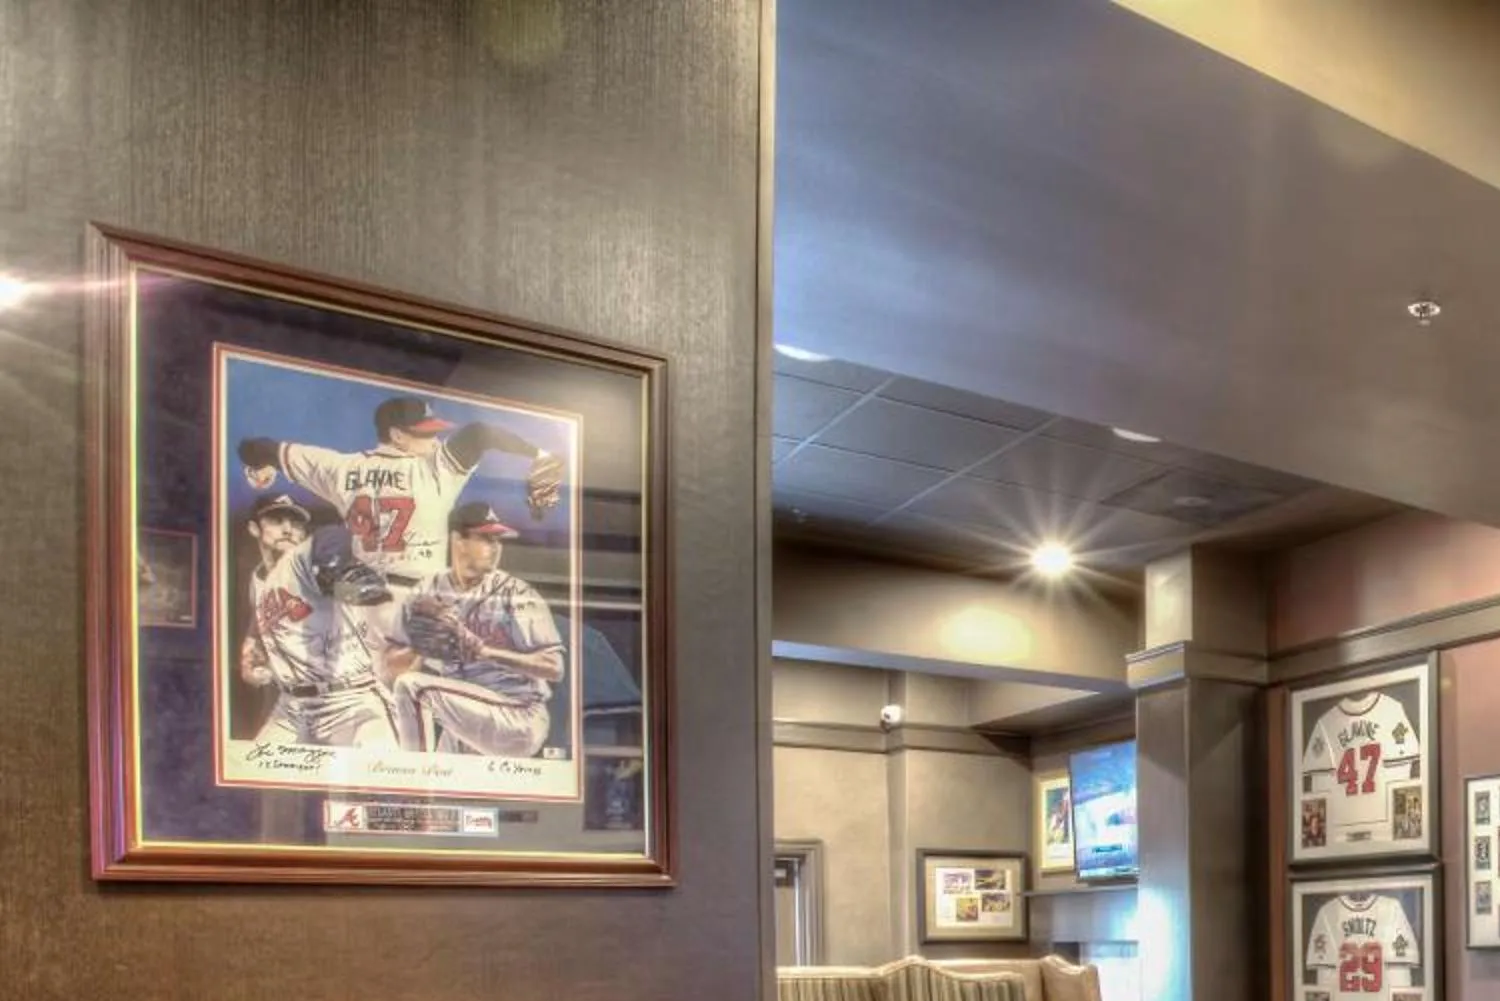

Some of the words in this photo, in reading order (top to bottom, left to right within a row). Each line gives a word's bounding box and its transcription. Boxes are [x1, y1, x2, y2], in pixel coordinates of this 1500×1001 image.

[346, 496, 415, 552] 47
[1337, 743, 1382, 797] 47
[1339, 941, 1382, 992] 29
